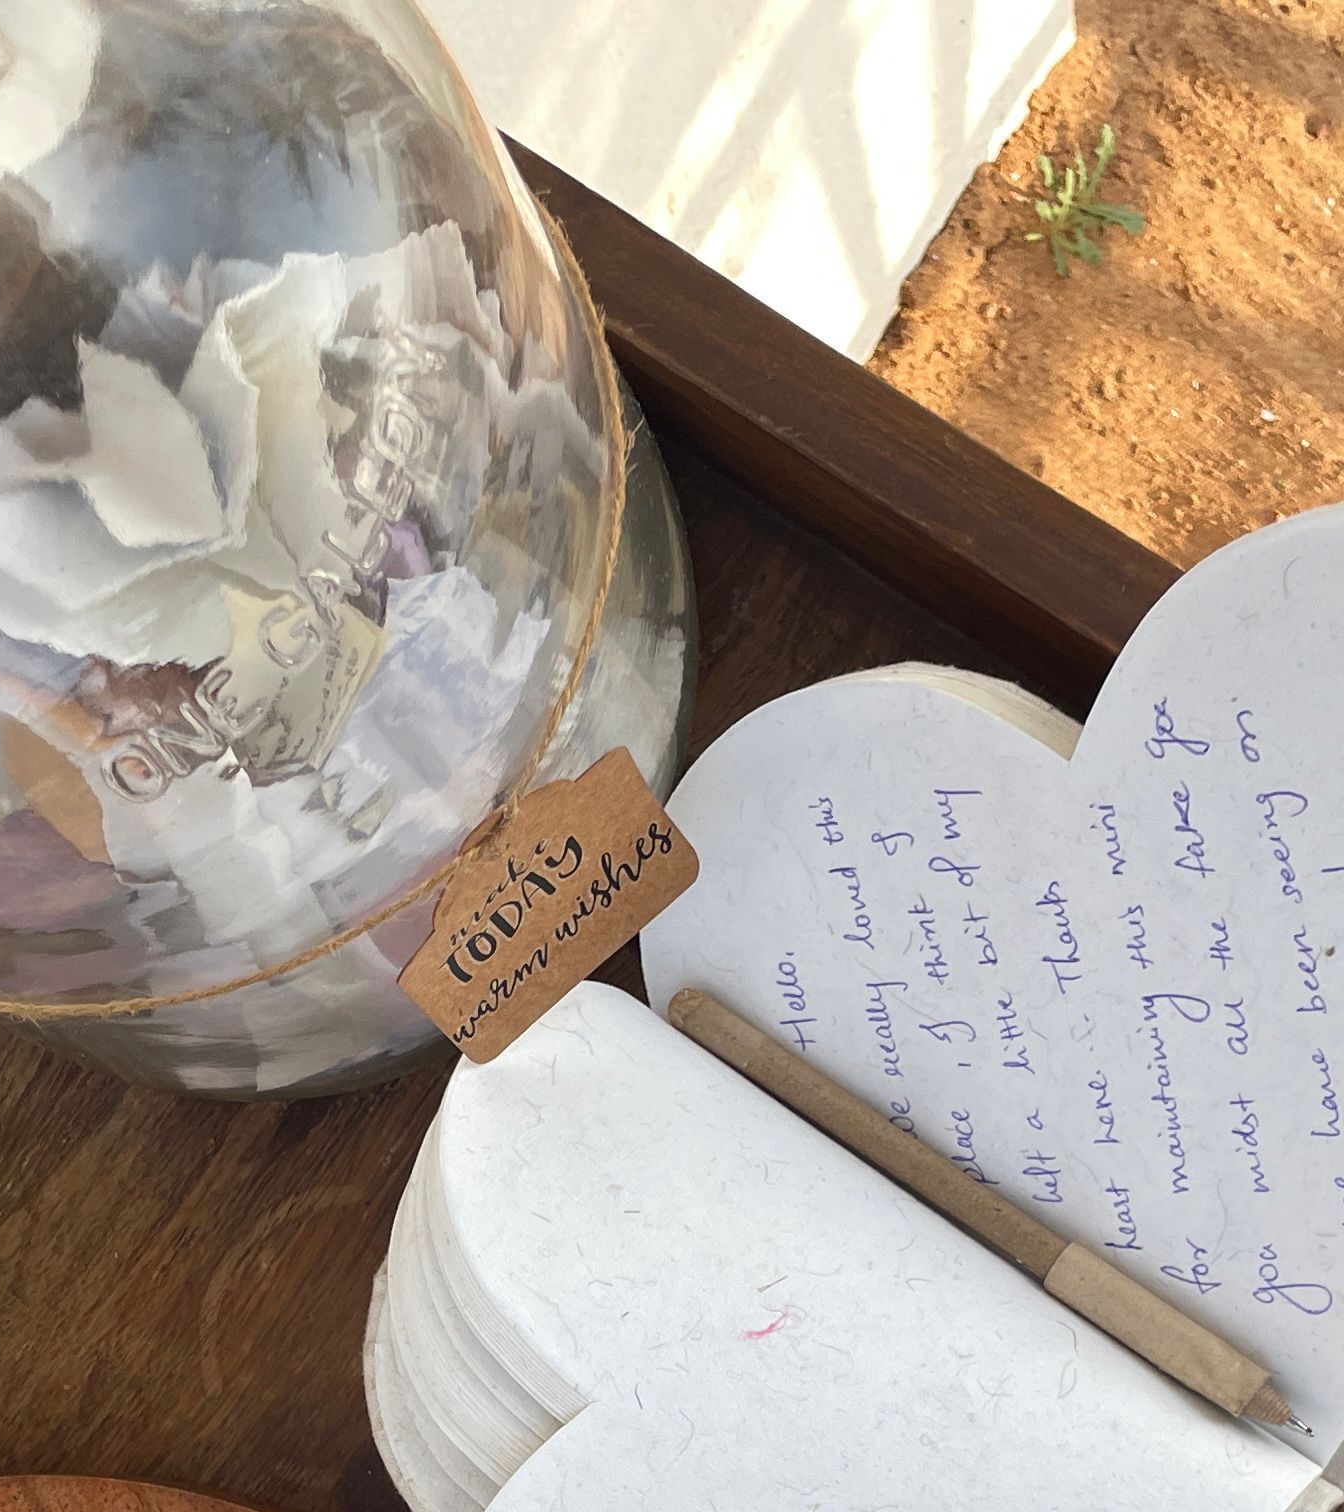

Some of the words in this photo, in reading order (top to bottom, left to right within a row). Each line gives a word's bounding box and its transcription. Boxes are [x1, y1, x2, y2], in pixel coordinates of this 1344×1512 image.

[102, 668, 263, 803] ONE
[814, 796, 846, 847] this
[931, 788, 983, 842] my
[1090, 803, 1128, 876] mini
[1172, 779, 1217, 880] fake
[1255, 790, 1309, 905] seeing
[450, 838, 550, 948] make
[828, 866, 875, 951] loved
[927, 855, 983, 889] of
[452, 942, 549, 1044] warm
[555, 822, 673, 942] wishes
[961, 903, 999, 967] bit
[1119, 903, 1153, 971] this
[1208, 916, 1235, 972] the
[1292, 923, 1329, 1015] been
[995, 991, 1035, 1074] little
[1223, 996, 1249, 1056] all
[1026, 1107, 1045, 1132] a
[1136, 993, 1212, 1195] maintaining
[1309, 1047, 1341, 1138] have
[1103, 1181, 1142, 1251] heart
[1159, 1236, 1222, 1295] for
